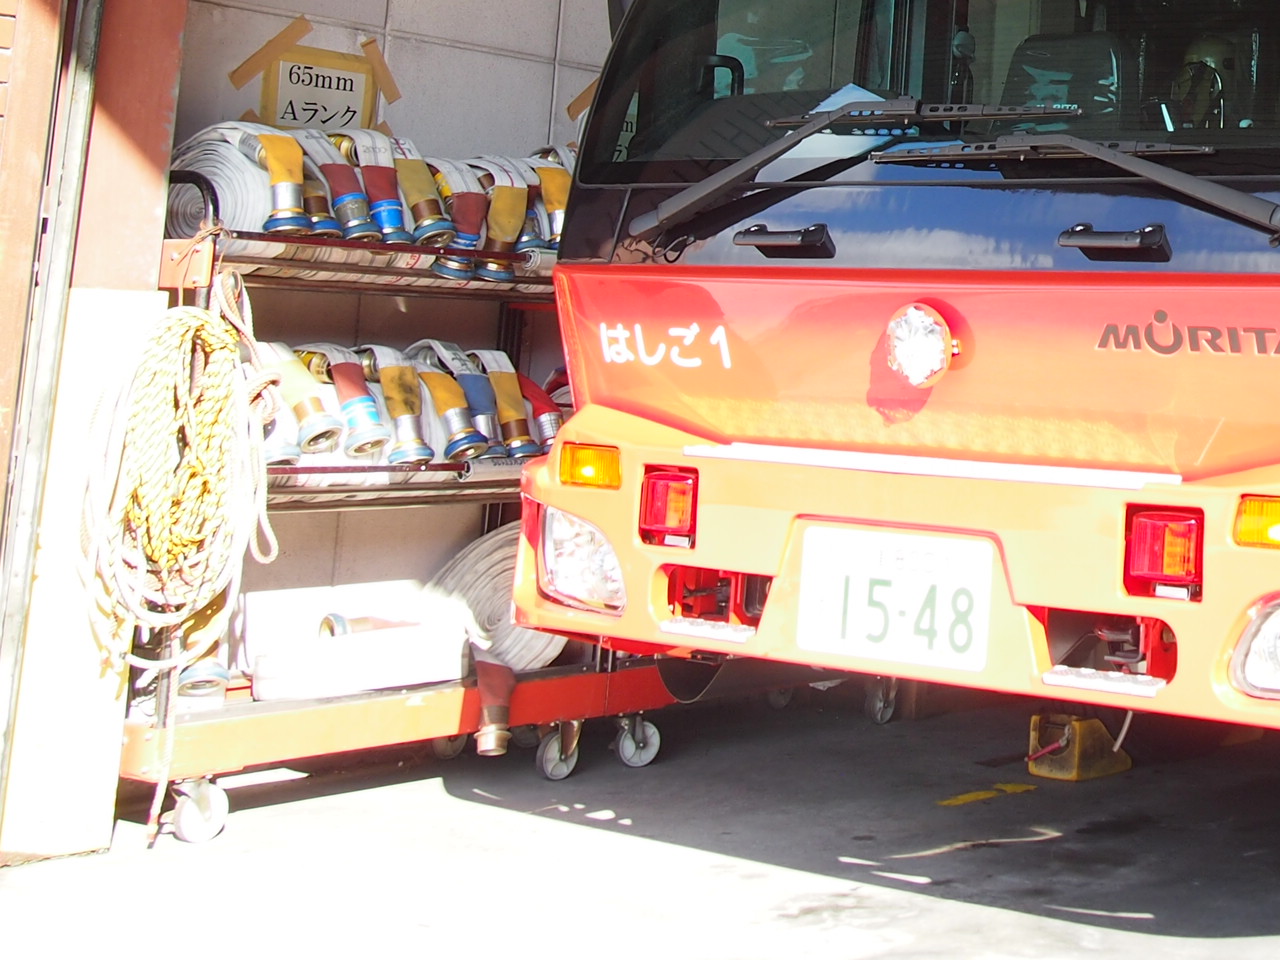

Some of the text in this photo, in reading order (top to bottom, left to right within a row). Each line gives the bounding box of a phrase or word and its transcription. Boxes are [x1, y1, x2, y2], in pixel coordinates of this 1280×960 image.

[288, 64, 355, 93] 65mm
[280, 99, 358, 128] Aランク
[599, 322, 732, 369] はしご1
[840, 574, 974, 654] 15-48
